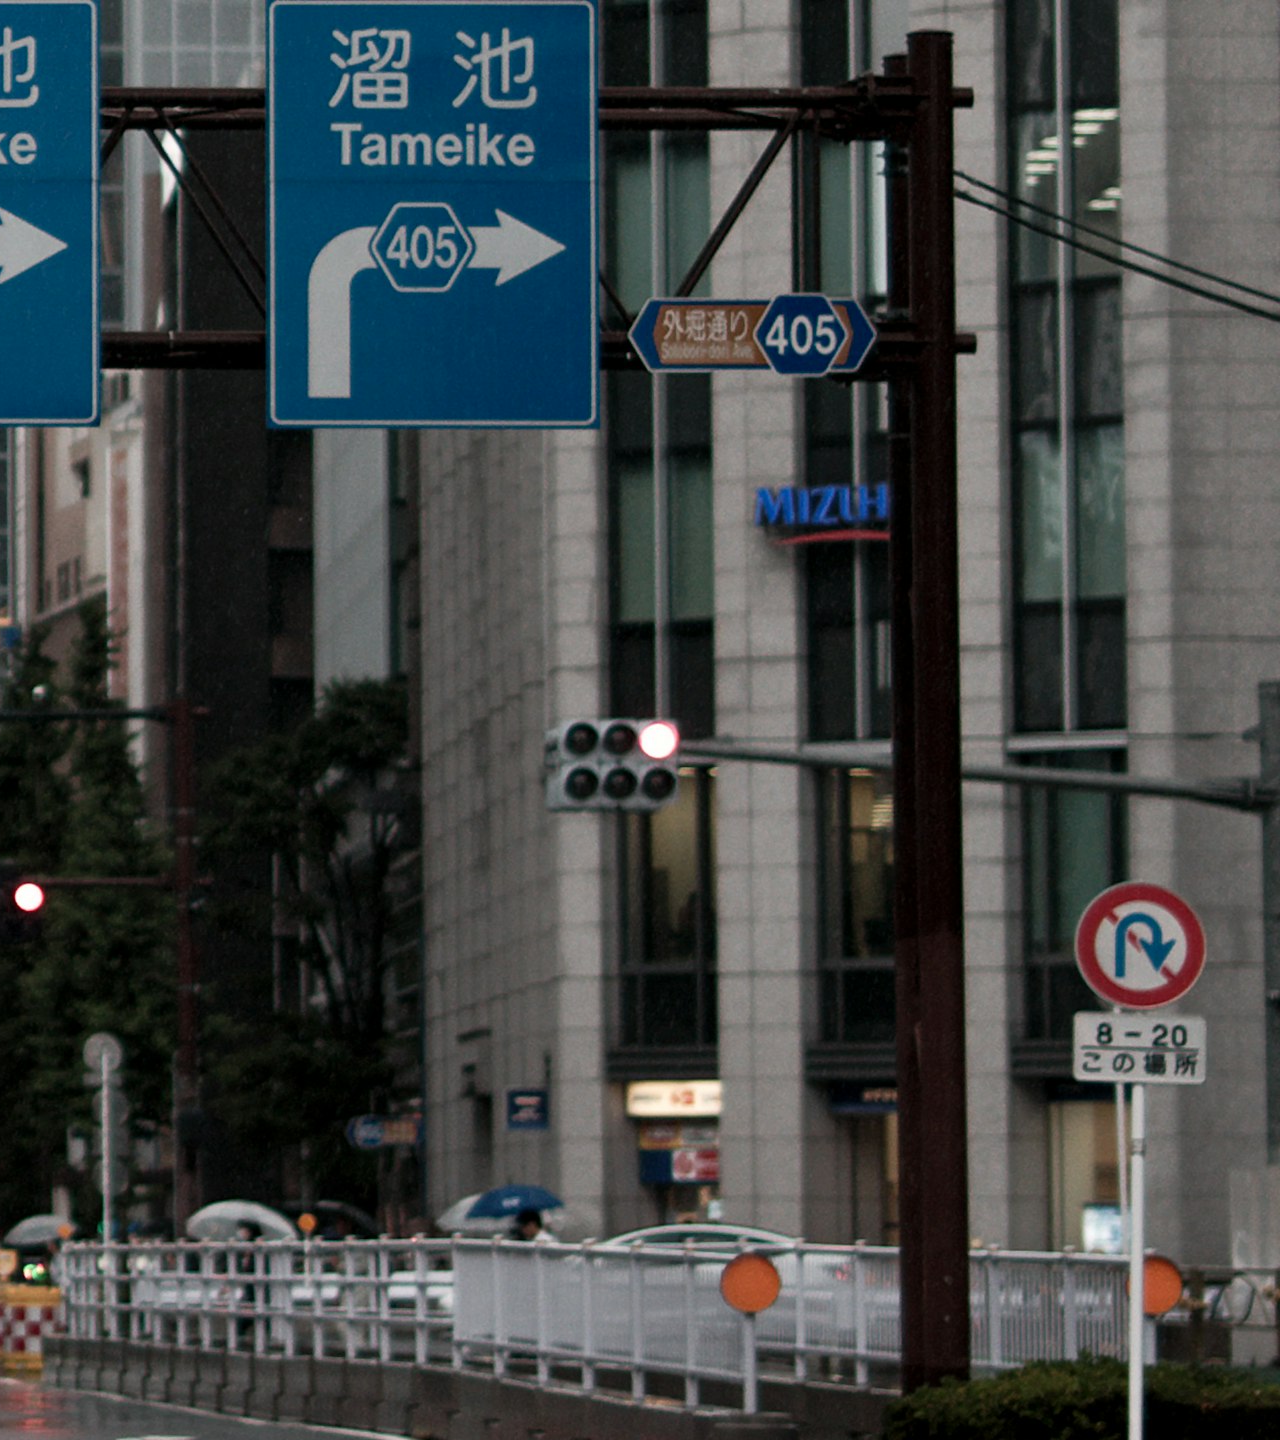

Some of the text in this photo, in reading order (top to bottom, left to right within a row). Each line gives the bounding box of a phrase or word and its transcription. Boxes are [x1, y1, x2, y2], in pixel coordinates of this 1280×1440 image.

[328, 27, 538, 109] 溜池
[330, 122, 535, 167] Tameike
[386, 225, 458, 269] 405
[663, 309, 748, 341] 外堀通り
[765, 314, 838, 355] 405
[755, 483, 888, 526] MIZUH
[1082, 1051, 1198, 1077] この場所
